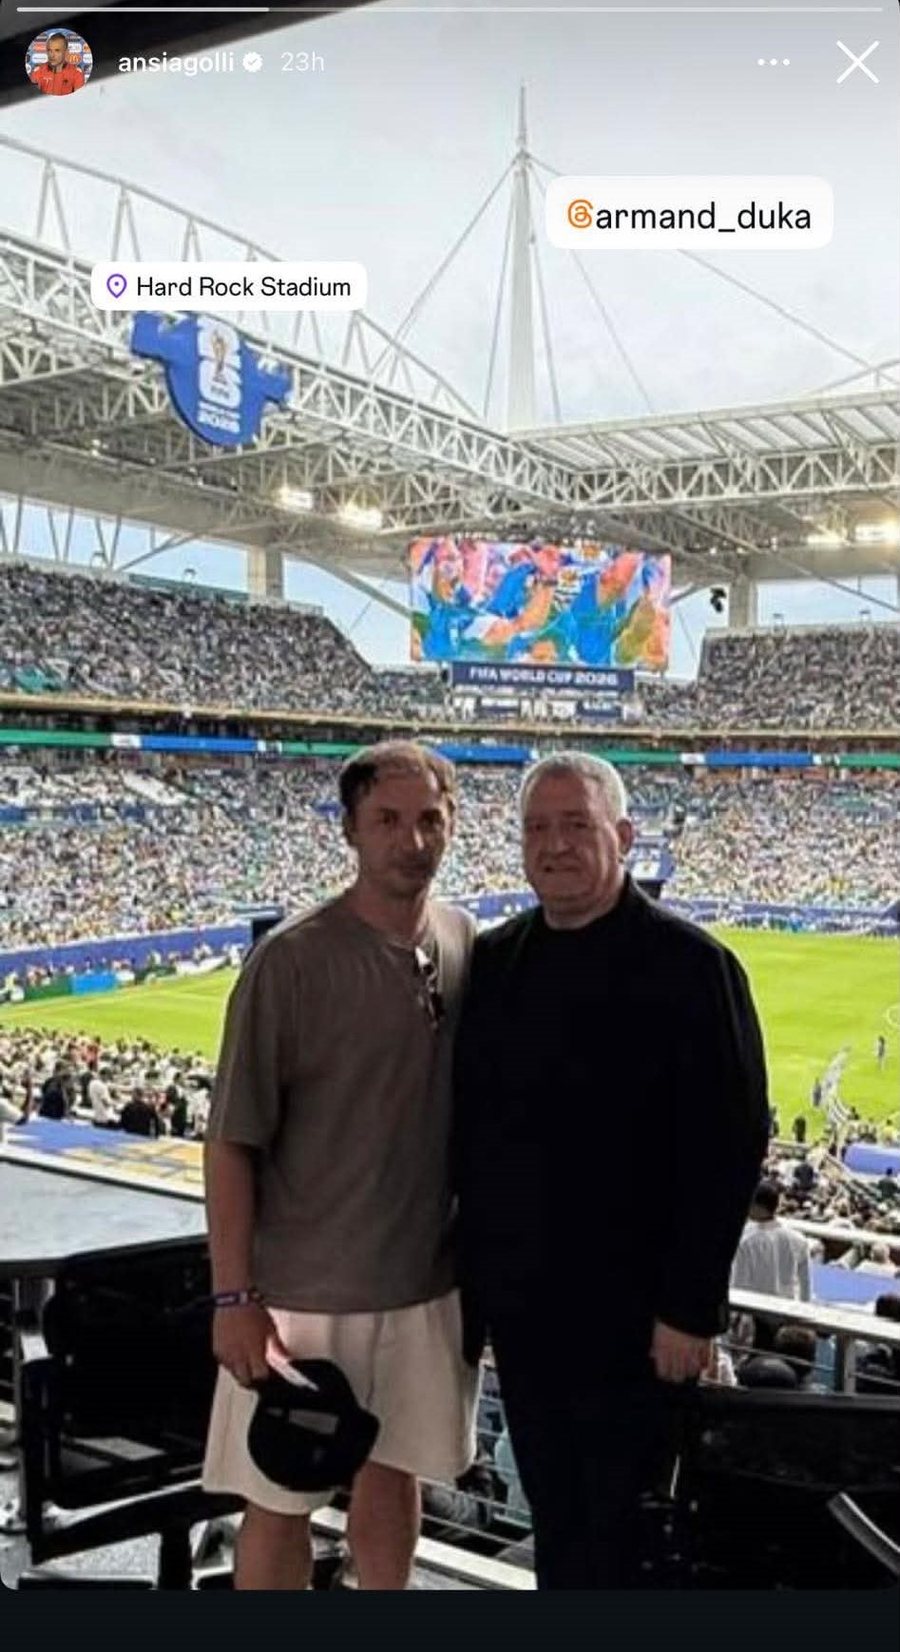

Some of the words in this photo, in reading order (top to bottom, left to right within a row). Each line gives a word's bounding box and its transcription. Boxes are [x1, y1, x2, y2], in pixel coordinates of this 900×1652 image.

[470, 666, 498, 681] FIFA
[500, 668, 545, 683] WORLD
[547, 671, 572, 684] CUP
[575, 671, 619, 686] 2026
